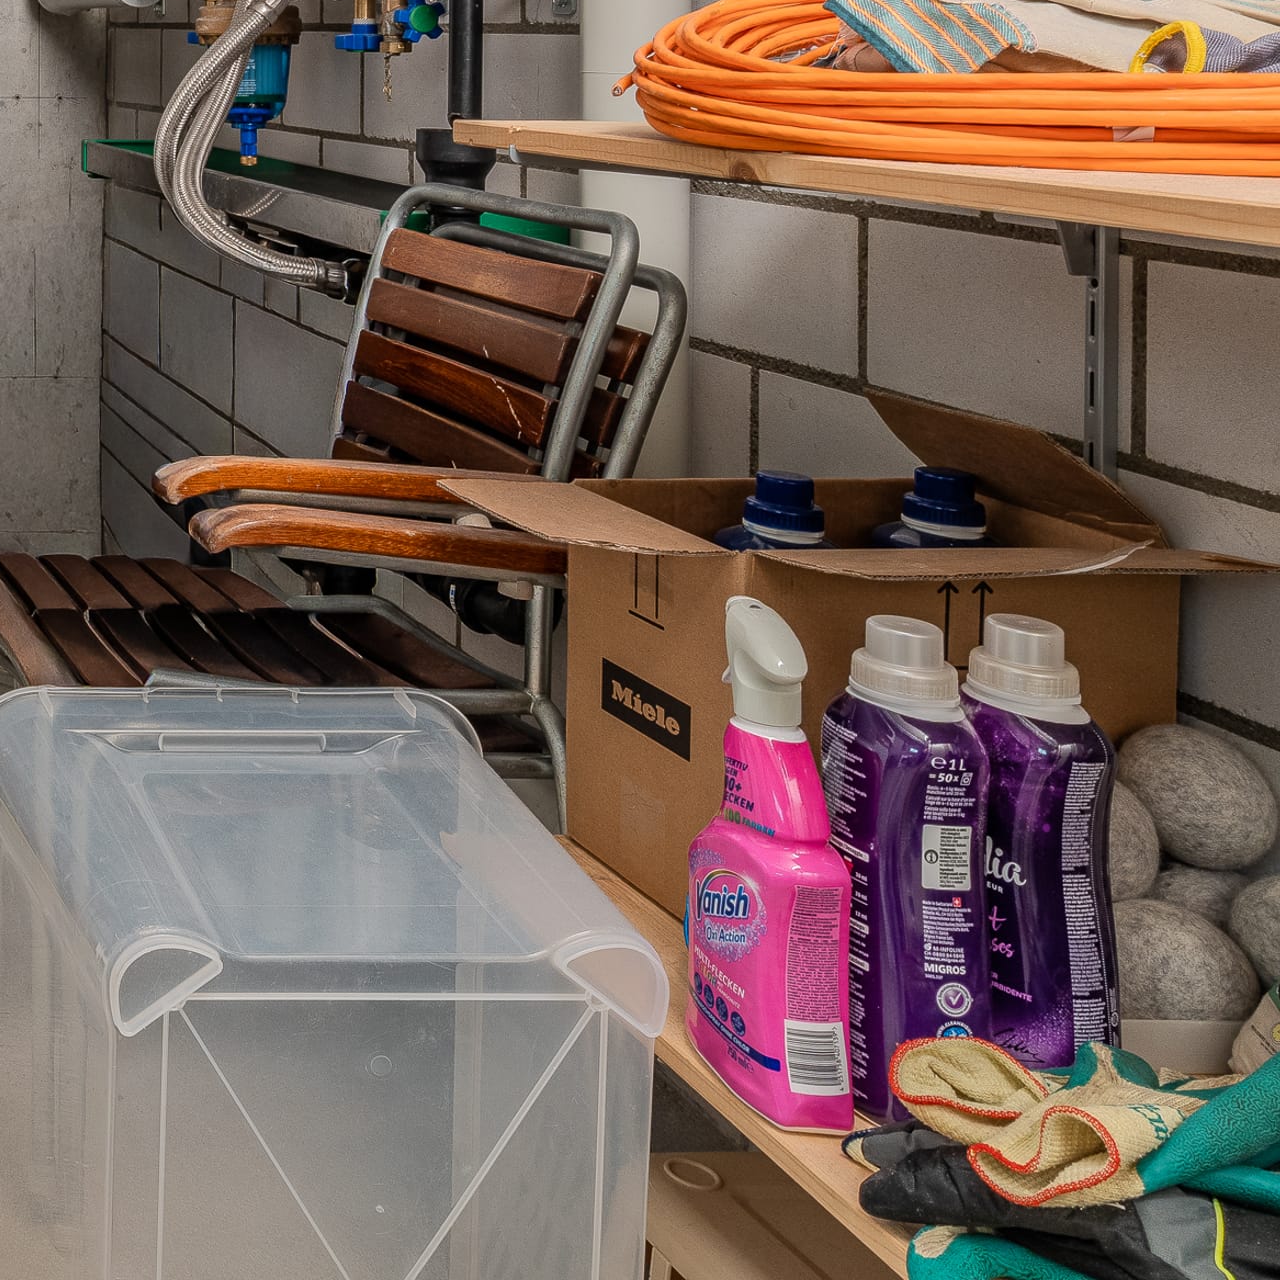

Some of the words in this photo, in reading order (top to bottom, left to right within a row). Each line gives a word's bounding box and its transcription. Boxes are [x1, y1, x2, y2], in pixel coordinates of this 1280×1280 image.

[611, 680, 680, 736] Miele
[695, 879, 750, 920] Vanish
[719, 927, 746, 943] Action
[694, 943, 745, 999] MULTI-FLECKEN
[924, 962, 967, 975] MIGROS
